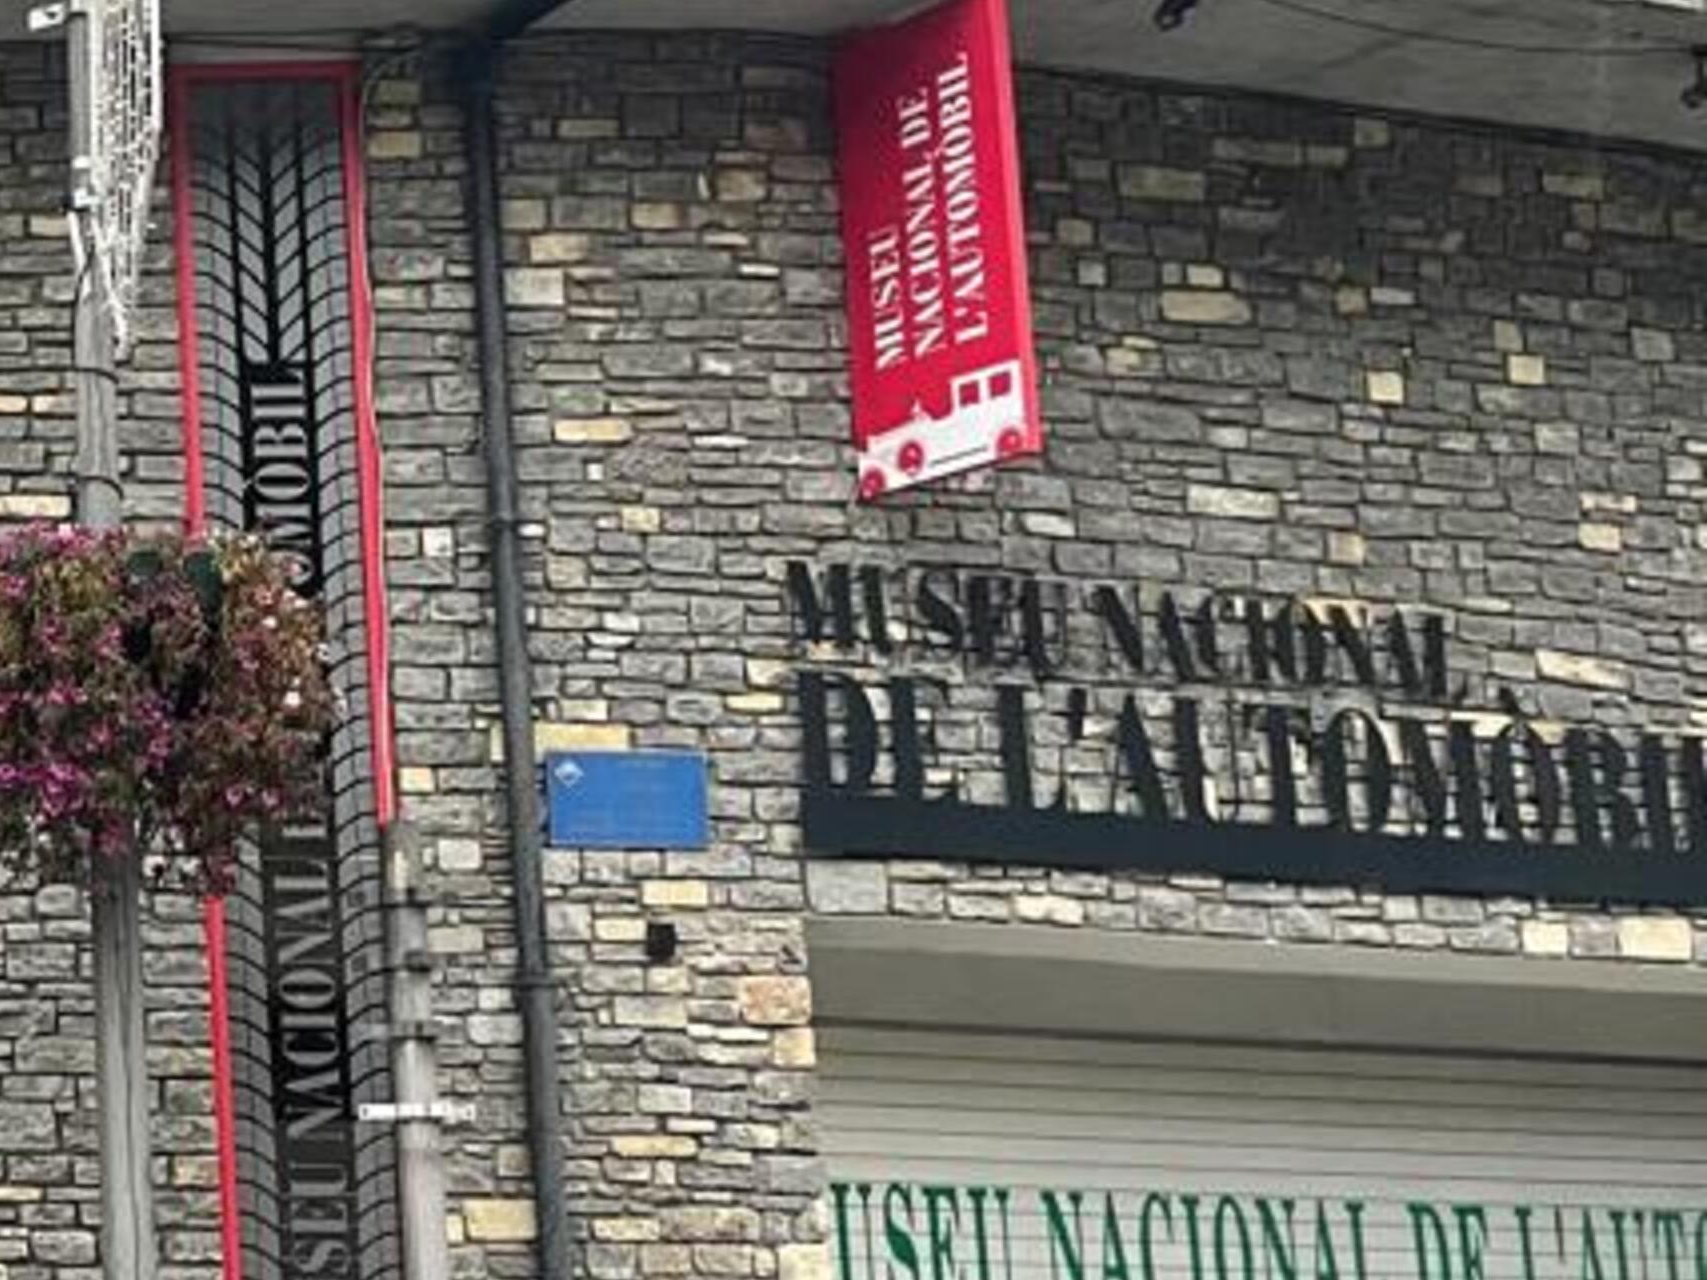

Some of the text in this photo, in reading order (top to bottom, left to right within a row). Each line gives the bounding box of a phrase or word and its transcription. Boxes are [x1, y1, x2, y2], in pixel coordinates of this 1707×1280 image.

[896, 86, 947, 359] NACIONAL DE
[867, 225, 907, 371] MUSEU
[786, 558, 1469, 702] MUSEU NACIONAL
[796, 671, 961, 802] DE
[273, 857, 345, 1141] NACIONAL
